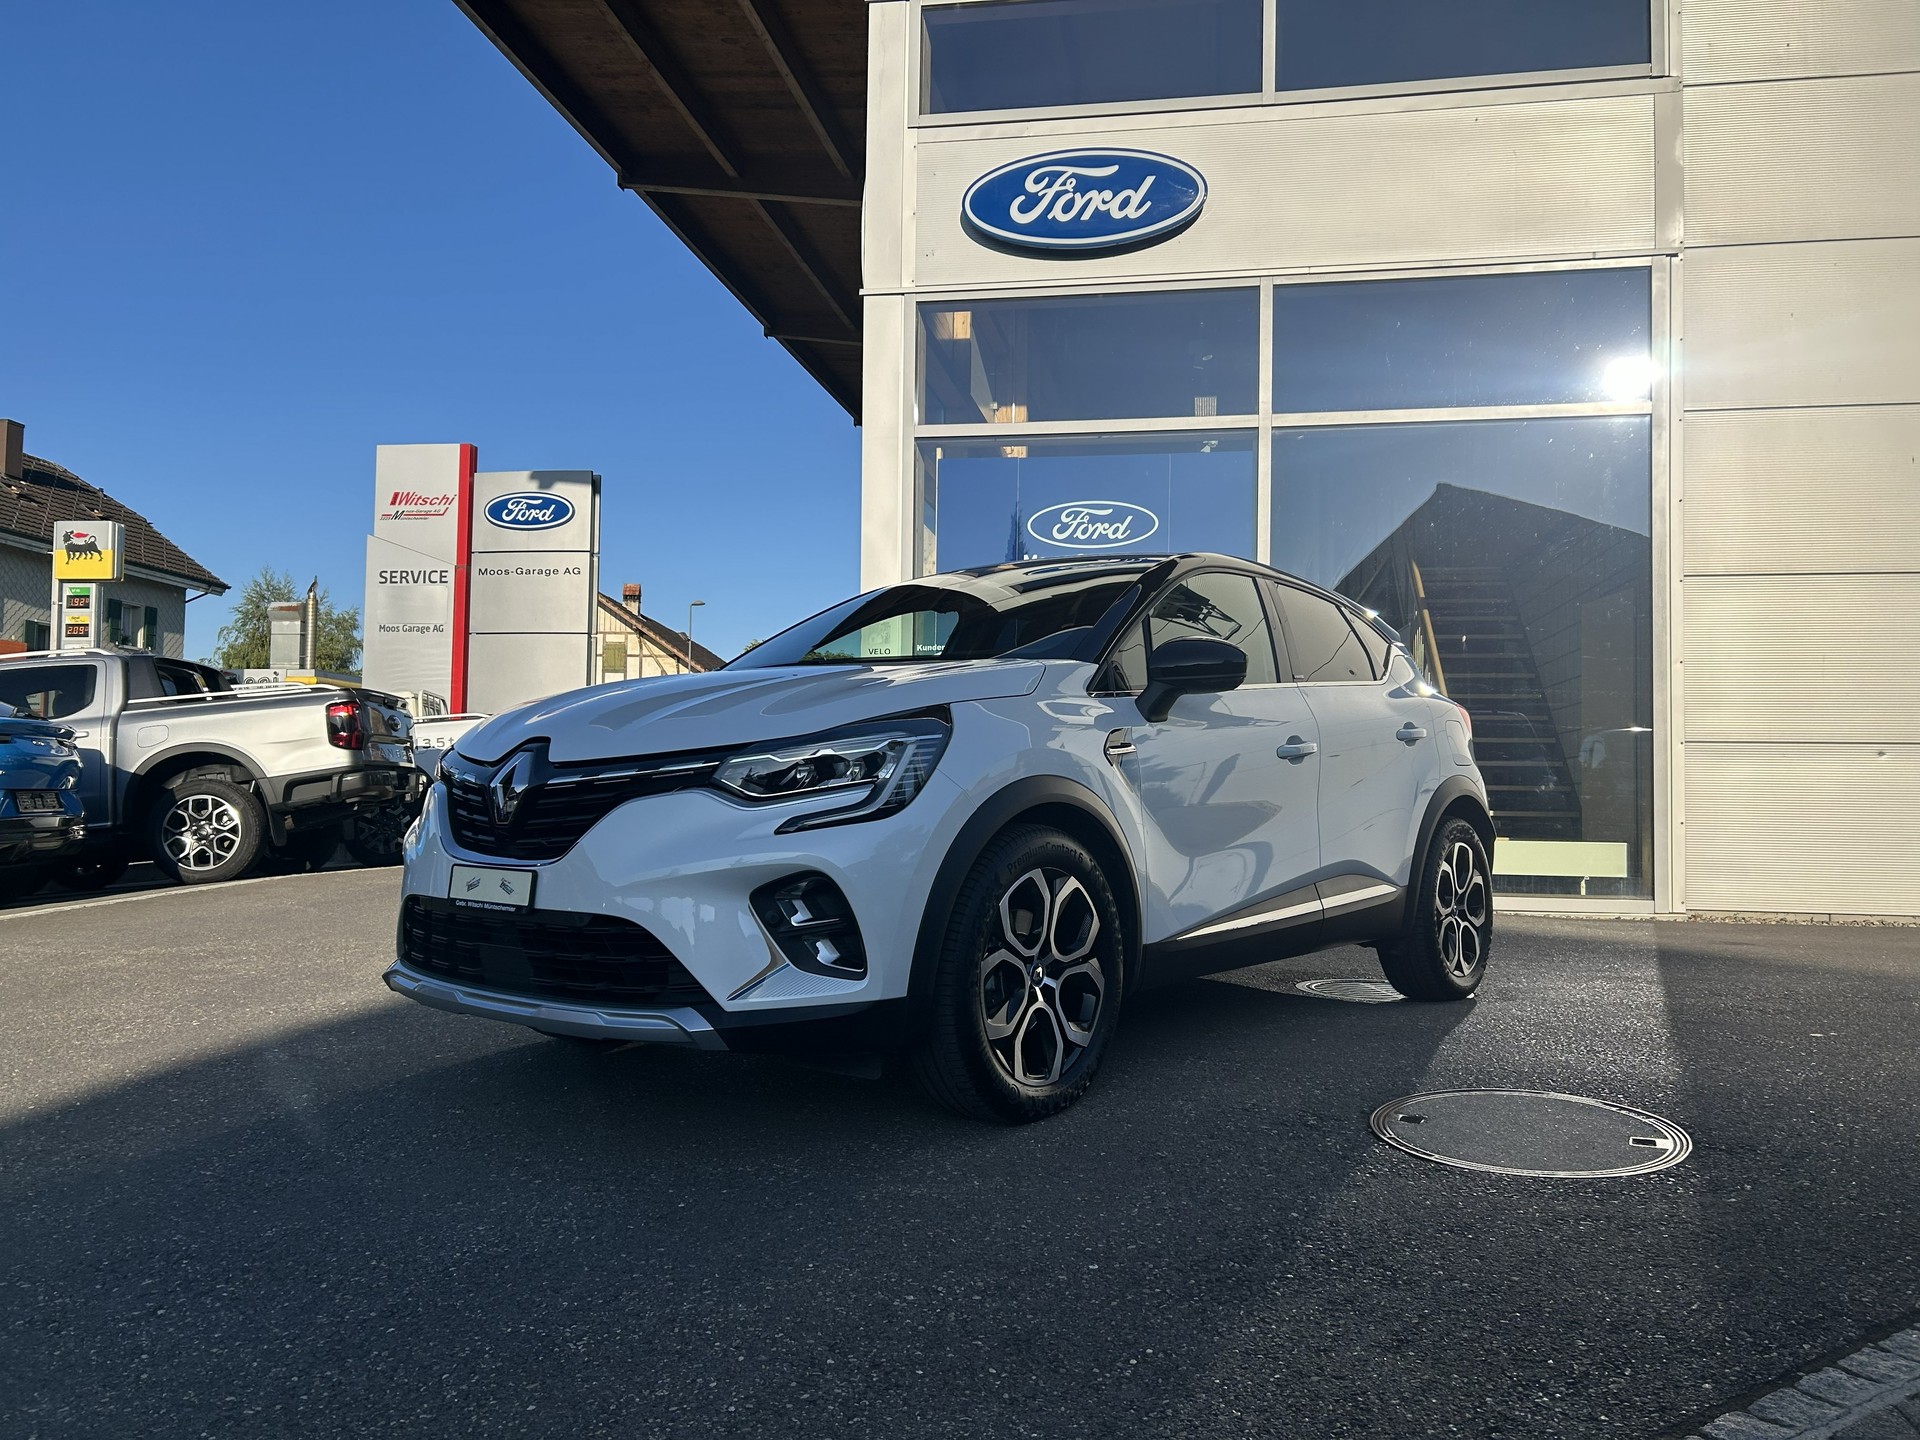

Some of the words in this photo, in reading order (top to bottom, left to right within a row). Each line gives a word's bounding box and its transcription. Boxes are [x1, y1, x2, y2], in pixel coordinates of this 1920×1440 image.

[1009, 165, 1156, 224] Ford
[397, 492, 457, 506] Witschi
[502, 498, 556, 521] Ford
[1052, 507, 1133, 540] Ford
[378, 570, 449, 584] SERVICE
[478, 567, 559, 577] Moos-Garage
[563, 567, 581, 575] AG
[379, 624, 400, 633] Moos
[402, 624, 431, 635] Garage
[432, 624, 444, 633] AG
